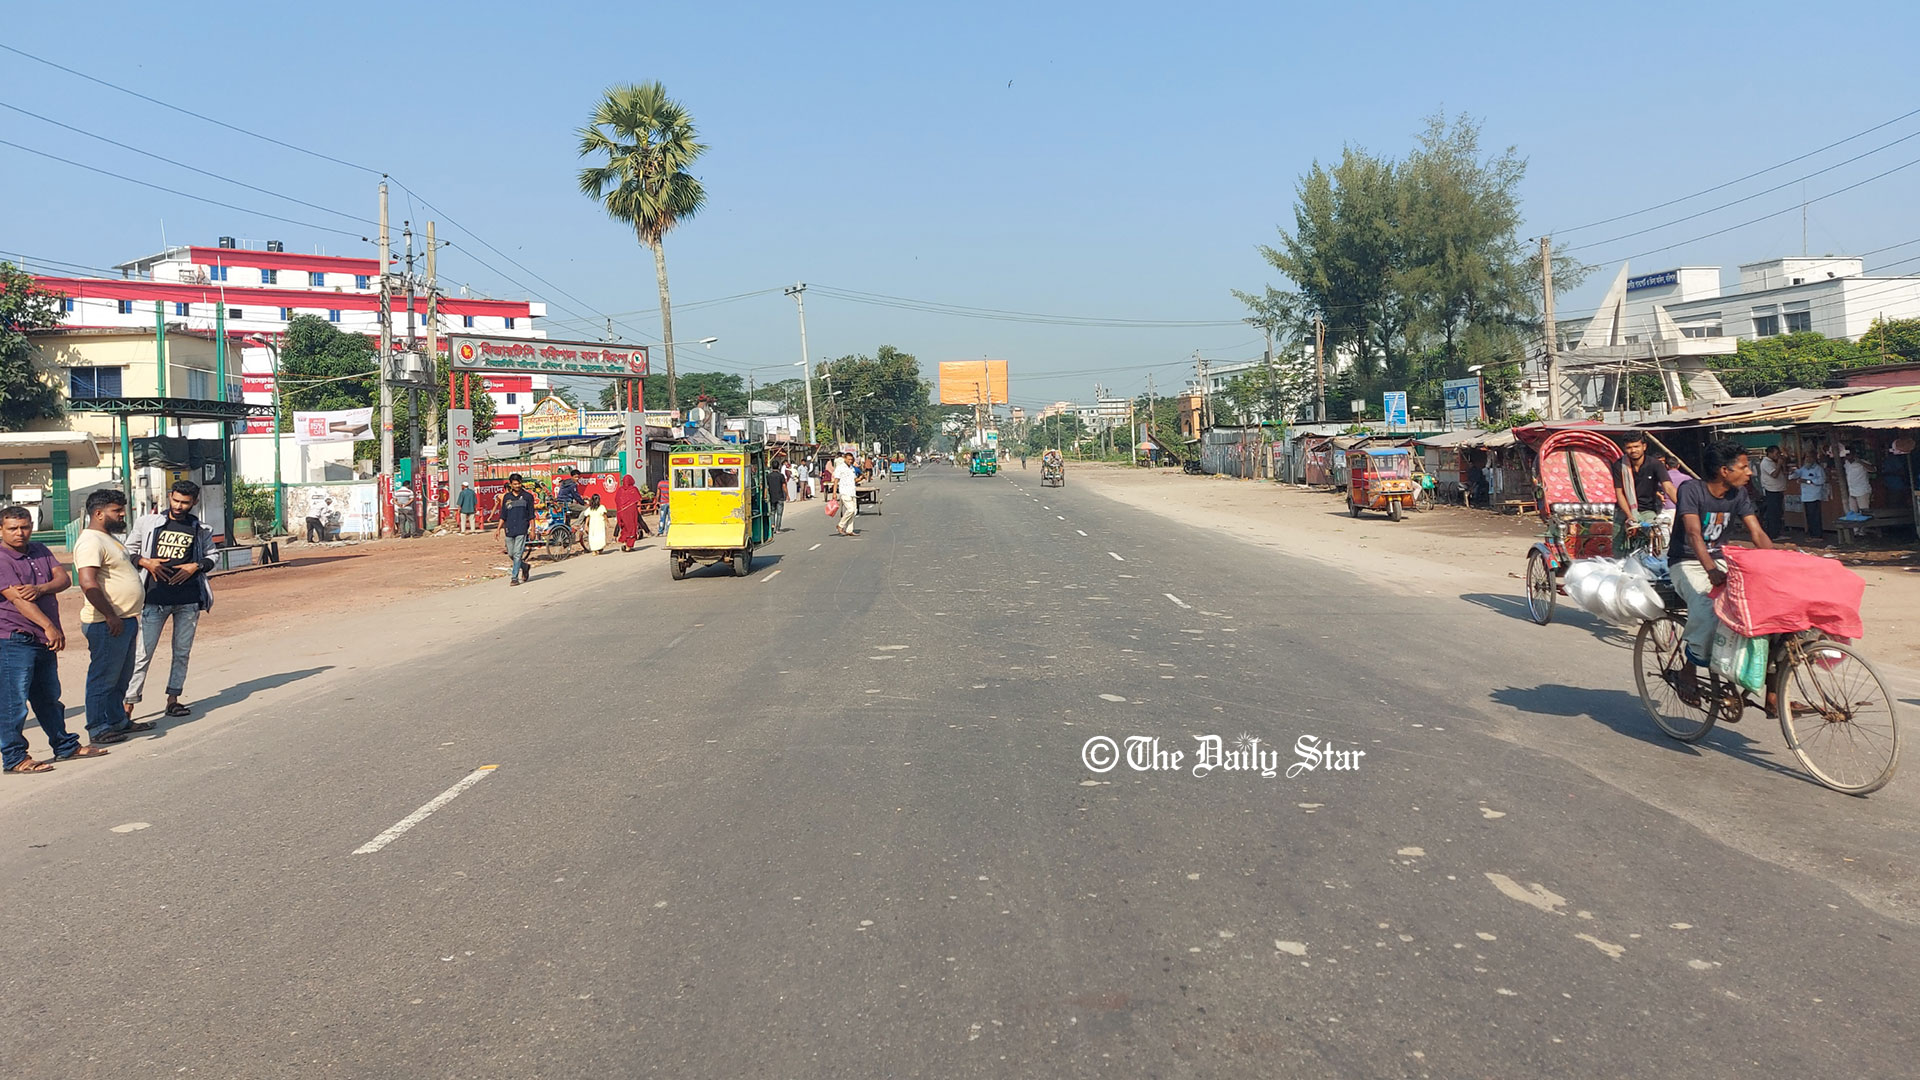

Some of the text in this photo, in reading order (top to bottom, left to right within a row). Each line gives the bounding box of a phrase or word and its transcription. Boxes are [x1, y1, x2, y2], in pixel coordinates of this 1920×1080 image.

[480, 341, 628, 364] বিআরটিসি বরিশাল বাস ডিপো
[634, 425, 643, 470] BRTC
[157, 545, 185, 559] ONES
